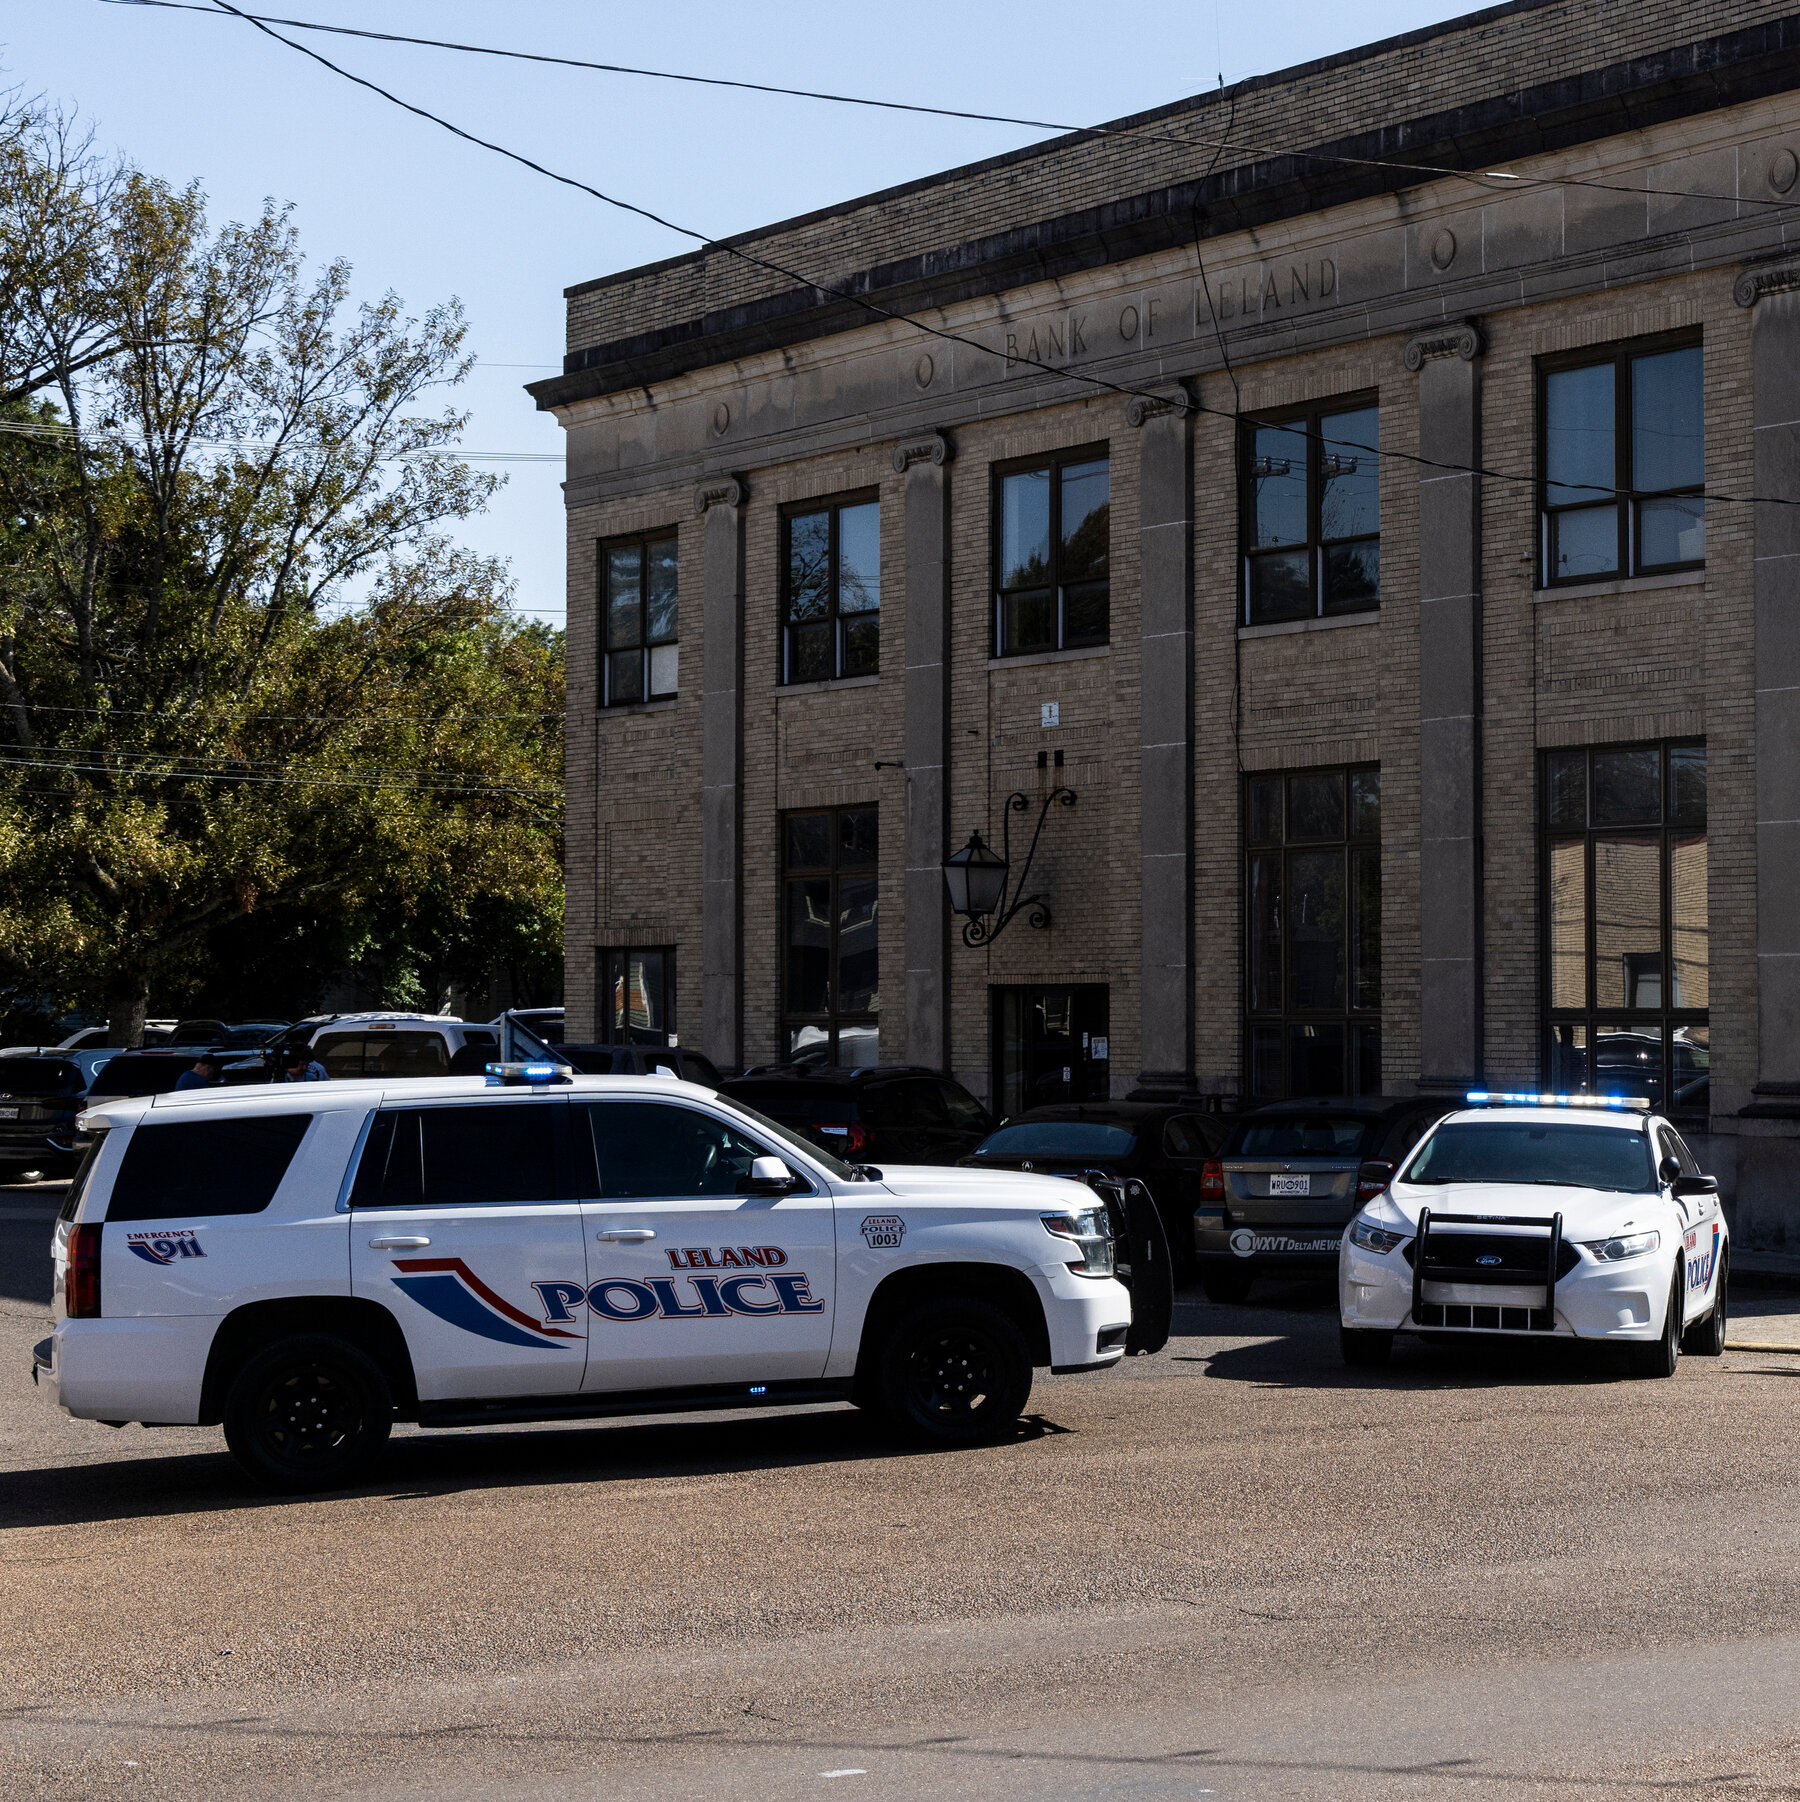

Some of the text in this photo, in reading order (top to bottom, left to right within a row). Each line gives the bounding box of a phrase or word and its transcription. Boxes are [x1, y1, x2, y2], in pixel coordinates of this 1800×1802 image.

[1005, 257, 1337, 369] BANK OF LELAND
[1271, 1180, 1308, 1190] WRU 901
[126, 1230, 195, 1240] EMERGENCY
[861, 1226, 905, 1234] POLICE
[872, 1234, 898, 1246] 1003
[1251, 1236, 1288, 1251] WXVT
[152, 1237, 208, 1260] 911
[664, 1247, 789, 1271] LELAND
[531, 1273, 825, 1323] POLICE
